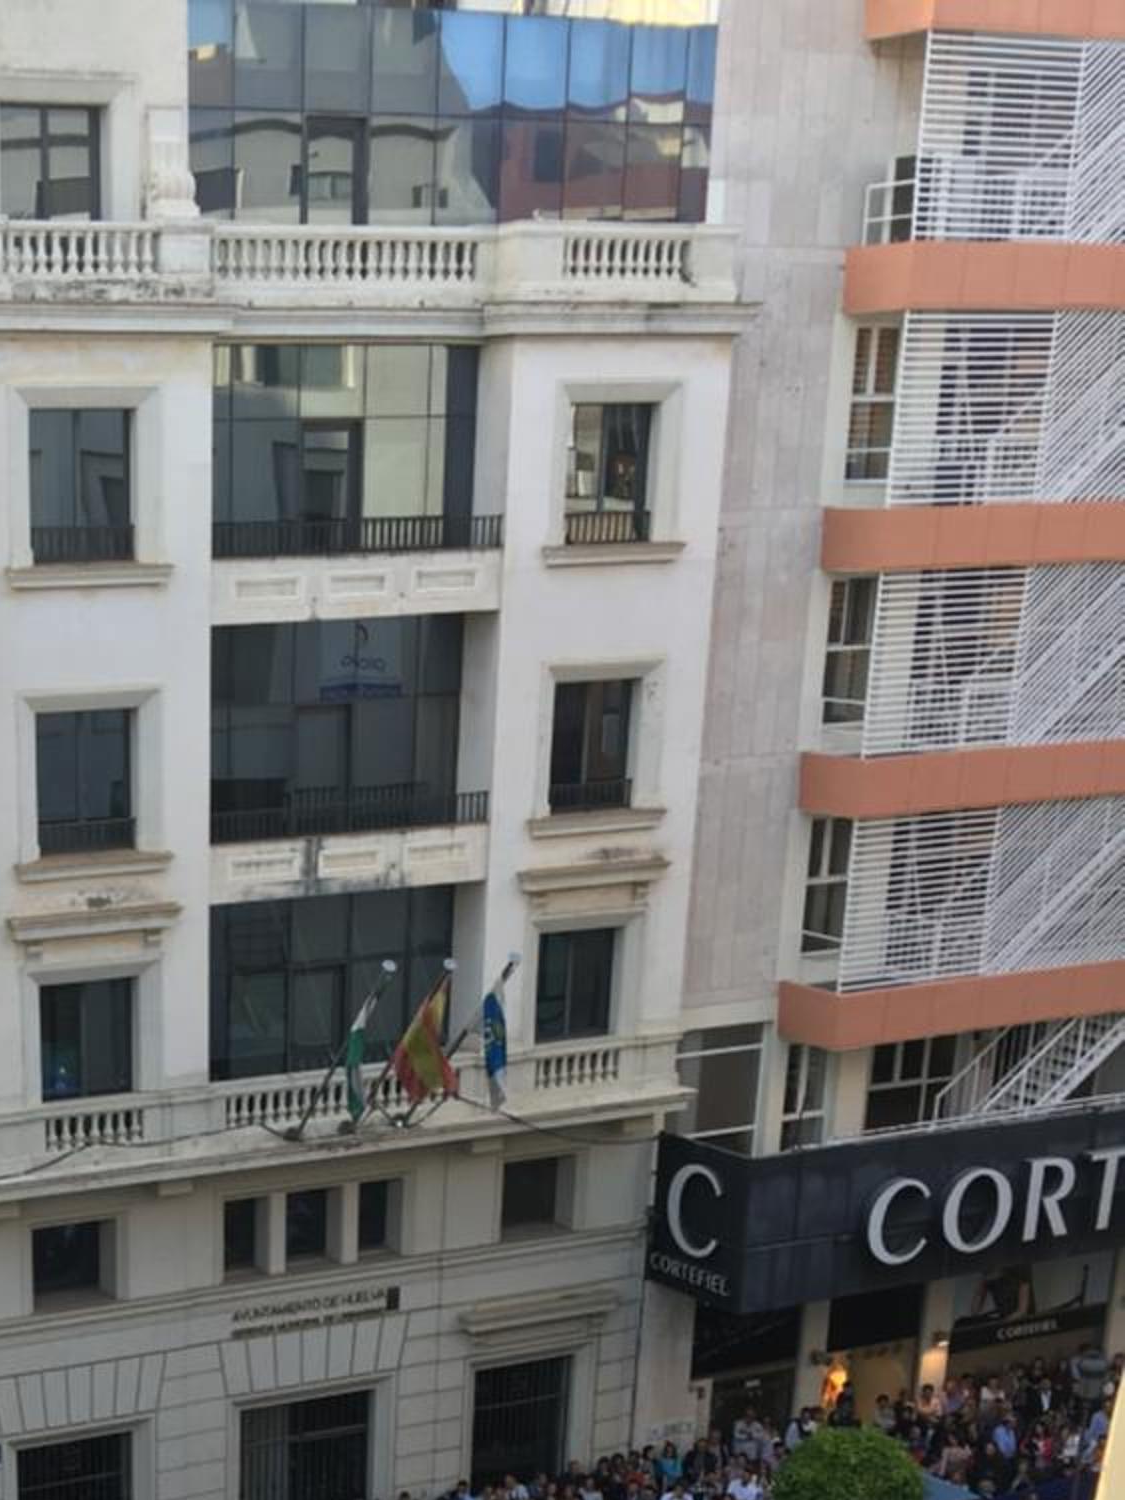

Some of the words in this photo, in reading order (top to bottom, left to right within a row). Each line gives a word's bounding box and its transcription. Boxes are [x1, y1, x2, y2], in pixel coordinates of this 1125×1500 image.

[667, 1164, 722, 1258] C
[868, 1149, 1125, 1265] CORT
[650, 1252, 730, 1297] CORTEFIEL
